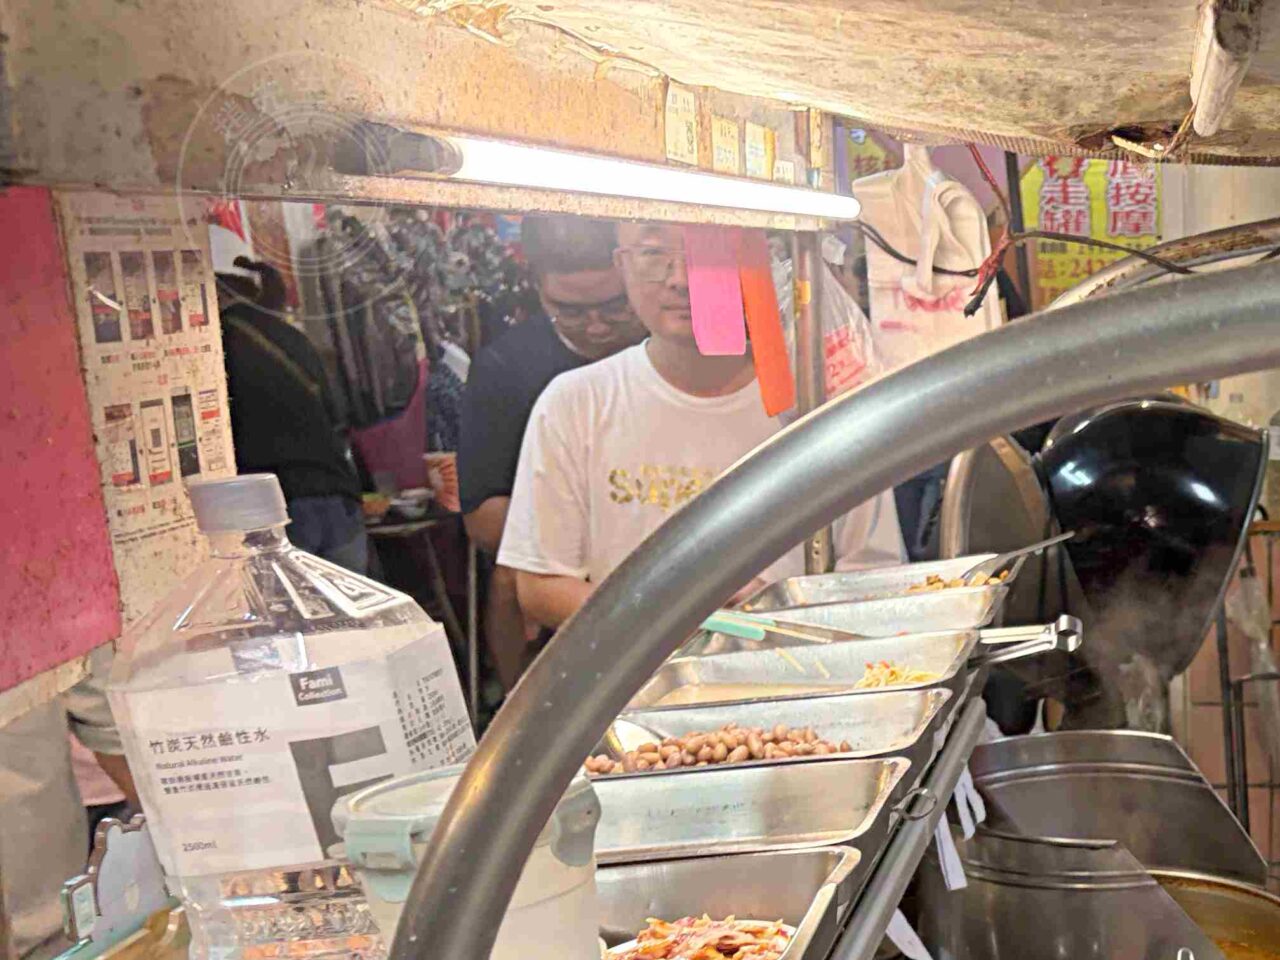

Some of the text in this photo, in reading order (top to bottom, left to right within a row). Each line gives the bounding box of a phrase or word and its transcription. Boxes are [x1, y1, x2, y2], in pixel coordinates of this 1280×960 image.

[300, 673, 334, 690] Fami
[298, 688, 343, 700] Collection
[149, 727, 271, 755] 竹炭天然鹼性水
